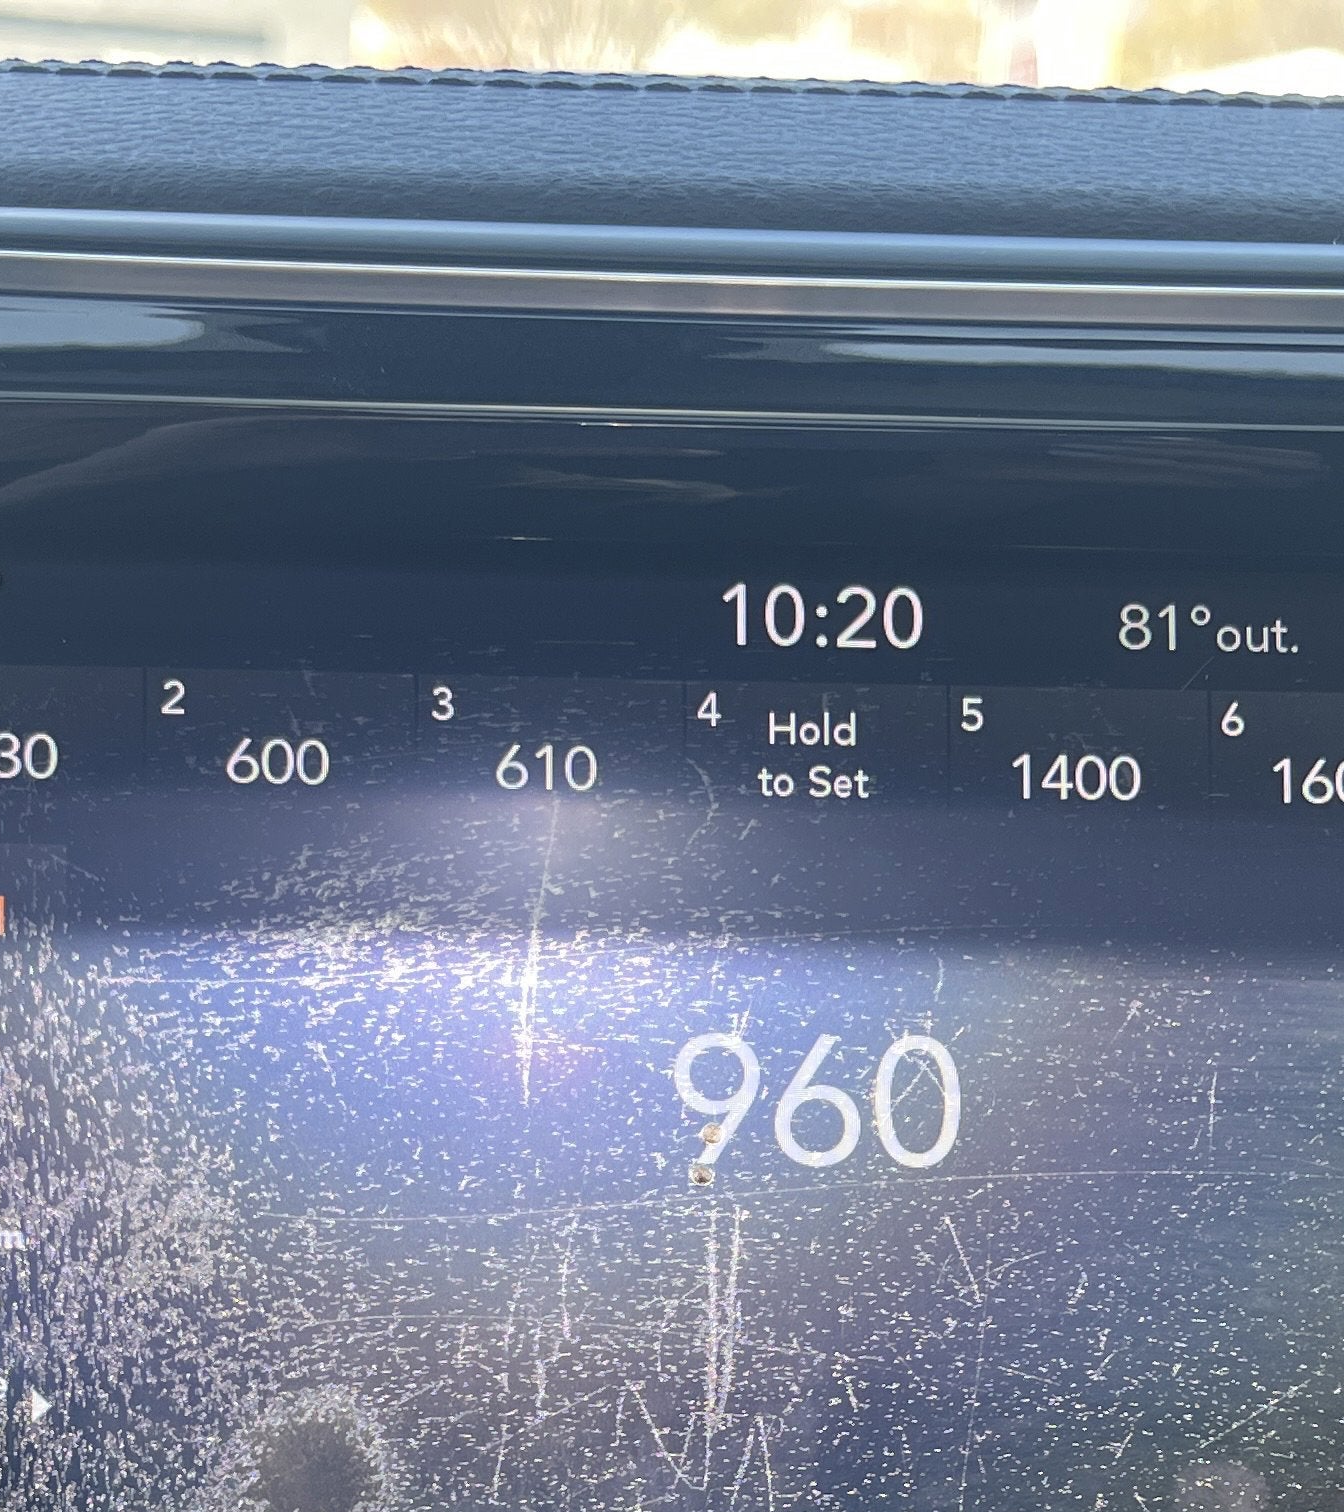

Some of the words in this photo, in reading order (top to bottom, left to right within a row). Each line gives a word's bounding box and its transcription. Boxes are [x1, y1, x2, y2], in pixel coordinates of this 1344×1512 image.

[721, 582, 925, 650] 10:20
[160, 679, 186, 715] 2
[431, 686, 455, 722] 3
[696, 692, 722, 727] 4
[960, 697, 984, 732] 5
[767, 710, 858, 749] Hold
[1220, 701, 1245, 738] 6
[226, 737, 330, 786] 600
[495, 744, 598, 792] 610
[1010, 753, 1142, 803] 1400
[758, 767, 799, 800] to
[808, 765, 870, 800] Set
[672, 1032, 962, 1168] 960
